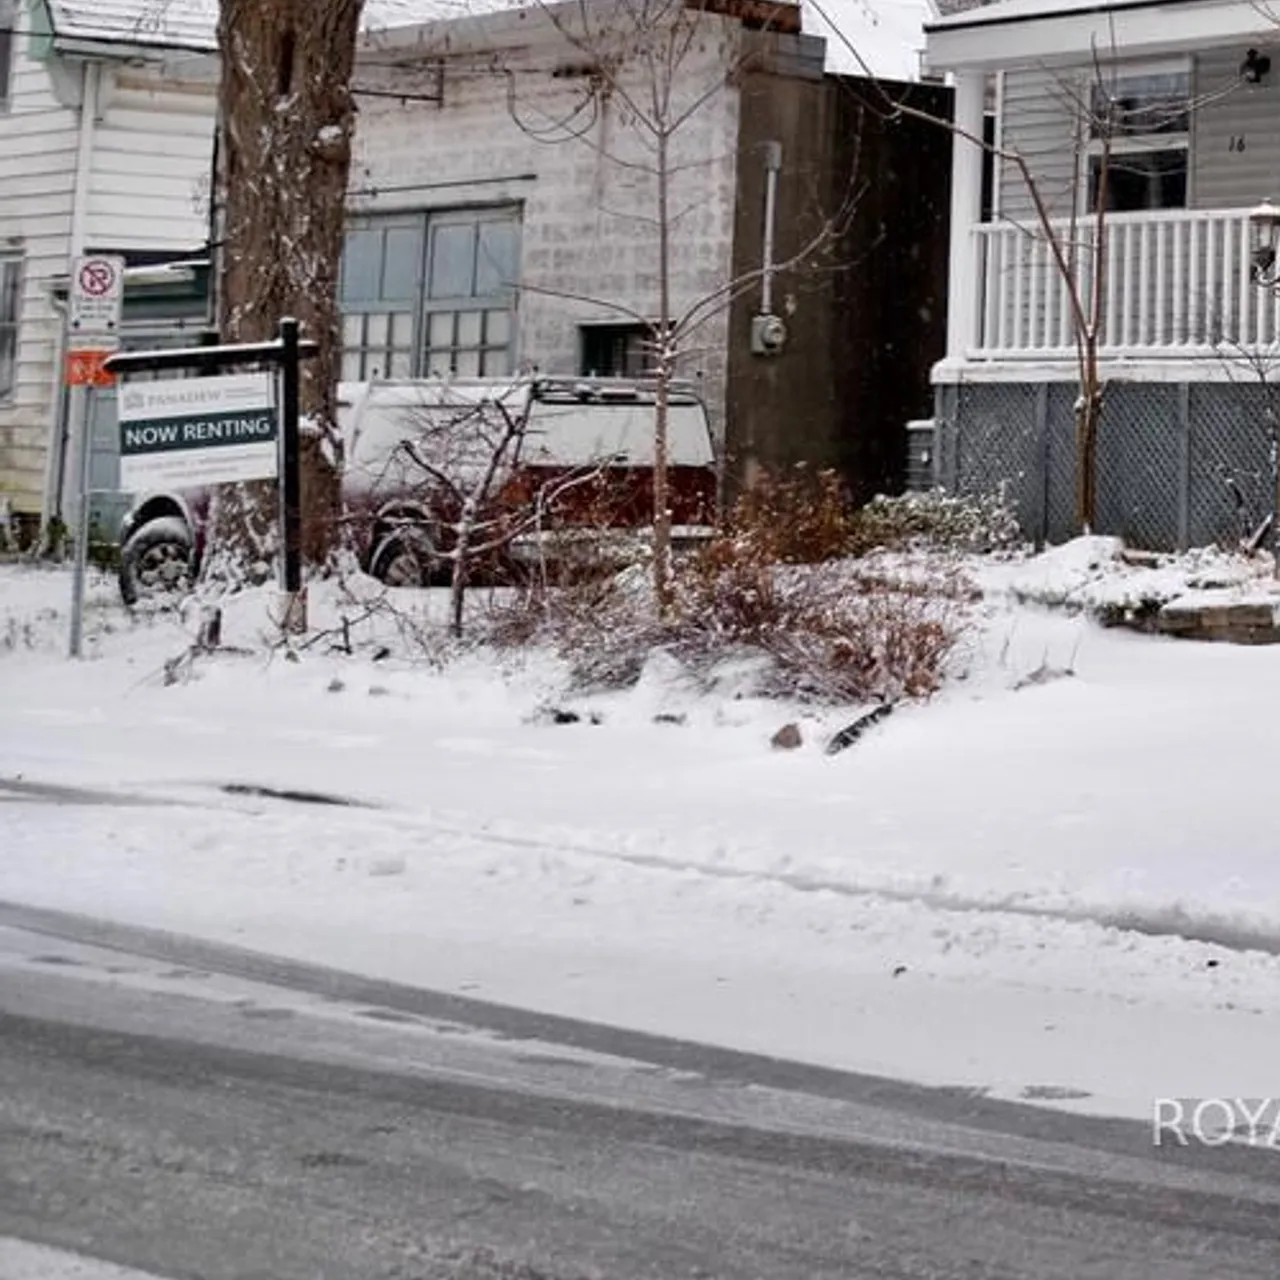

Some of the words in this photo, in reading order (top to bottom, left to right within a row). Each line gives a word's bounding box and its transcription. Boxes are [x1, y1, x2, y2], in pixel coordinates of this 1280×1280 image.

[1229, 133, 1246, 152] 16
[125, 423, 178, 447] NOW
[183, 417, 271, 441] RENTING
